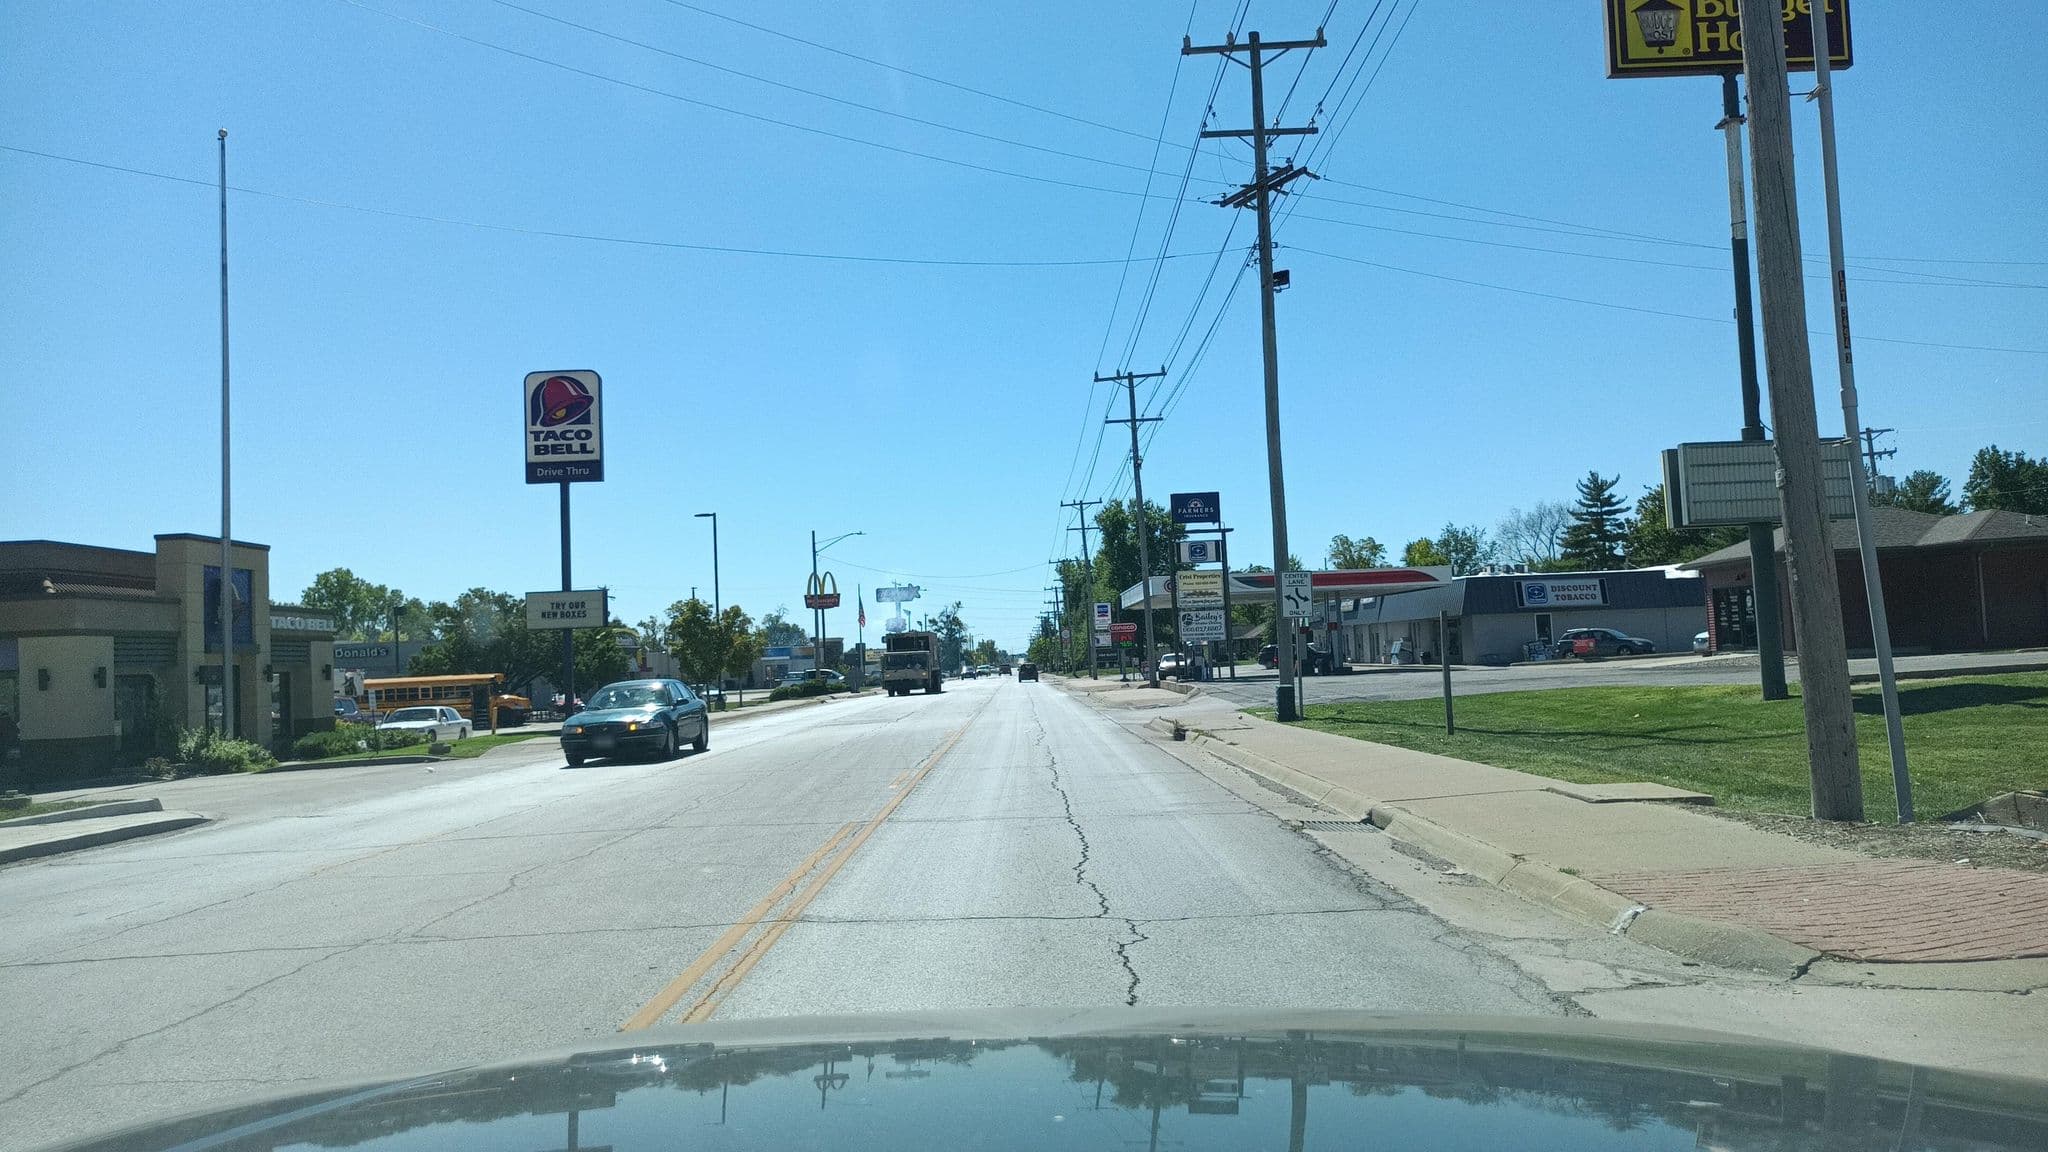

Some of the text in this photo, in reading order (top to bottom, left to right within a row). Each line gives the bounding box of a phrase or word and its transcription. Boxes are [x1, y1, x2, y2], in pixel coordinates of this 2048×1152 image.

[529, 429, 593, 442] TACO
[534, 443, 595, 455] BELL
[537, 466, 590, 477] Drive Thru
[1551, 584, 1598, 593] DISCOUNT
[1554, 593, 1597, 601] TOBACCO
[550, 601, 586, 610] TRY OUR
[541, 610, 587, 619] NEW BOXES
[270, 616, 337, 632] TACO BELL
[335, 648, 387, 658] Donald's
